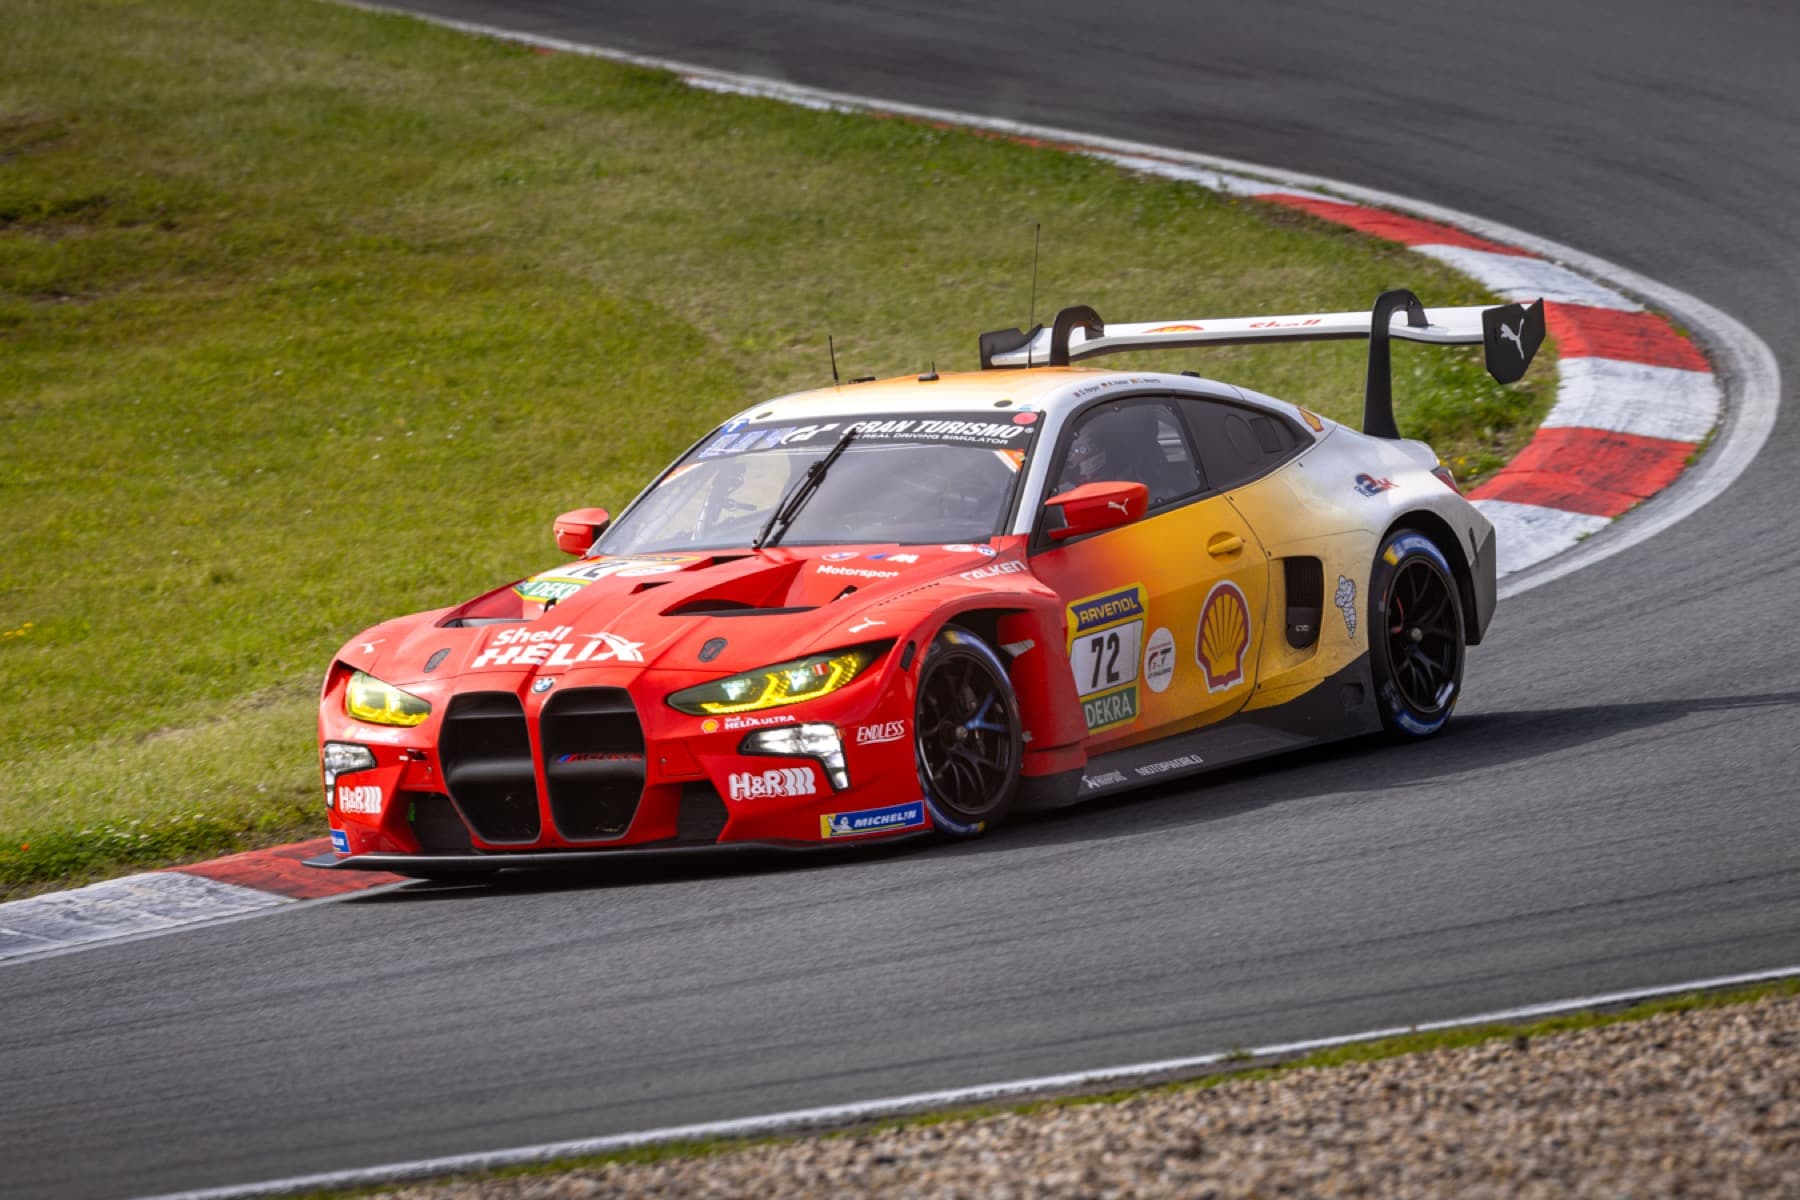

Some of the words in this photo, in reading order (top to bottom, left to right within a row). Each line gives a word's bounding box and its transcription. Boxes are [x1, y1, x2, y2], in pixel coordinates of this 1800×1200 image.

[843, 420, 915, 434] GRAN
[914, 420, 1024, 438] TURISMO
[942, 435, 1008, 445] SIMULATOR
[816, 565, 899, 578] Motorsport
[1080, 597, 1138, 624] RAVENOL
[492, 625, 573, 646] Shell
[470, 632, 645, 668] HELIX
[1091, 632, 1120, 688] 72
[760, 715, 796, 725] ULTRA
[1084, 693, 1133, 728] DEKRA
[856, 719, 905, 742] ENDLESS
[728, 770, 788, 802] H&R
[854, 810, 916, 828] MICHELIN
